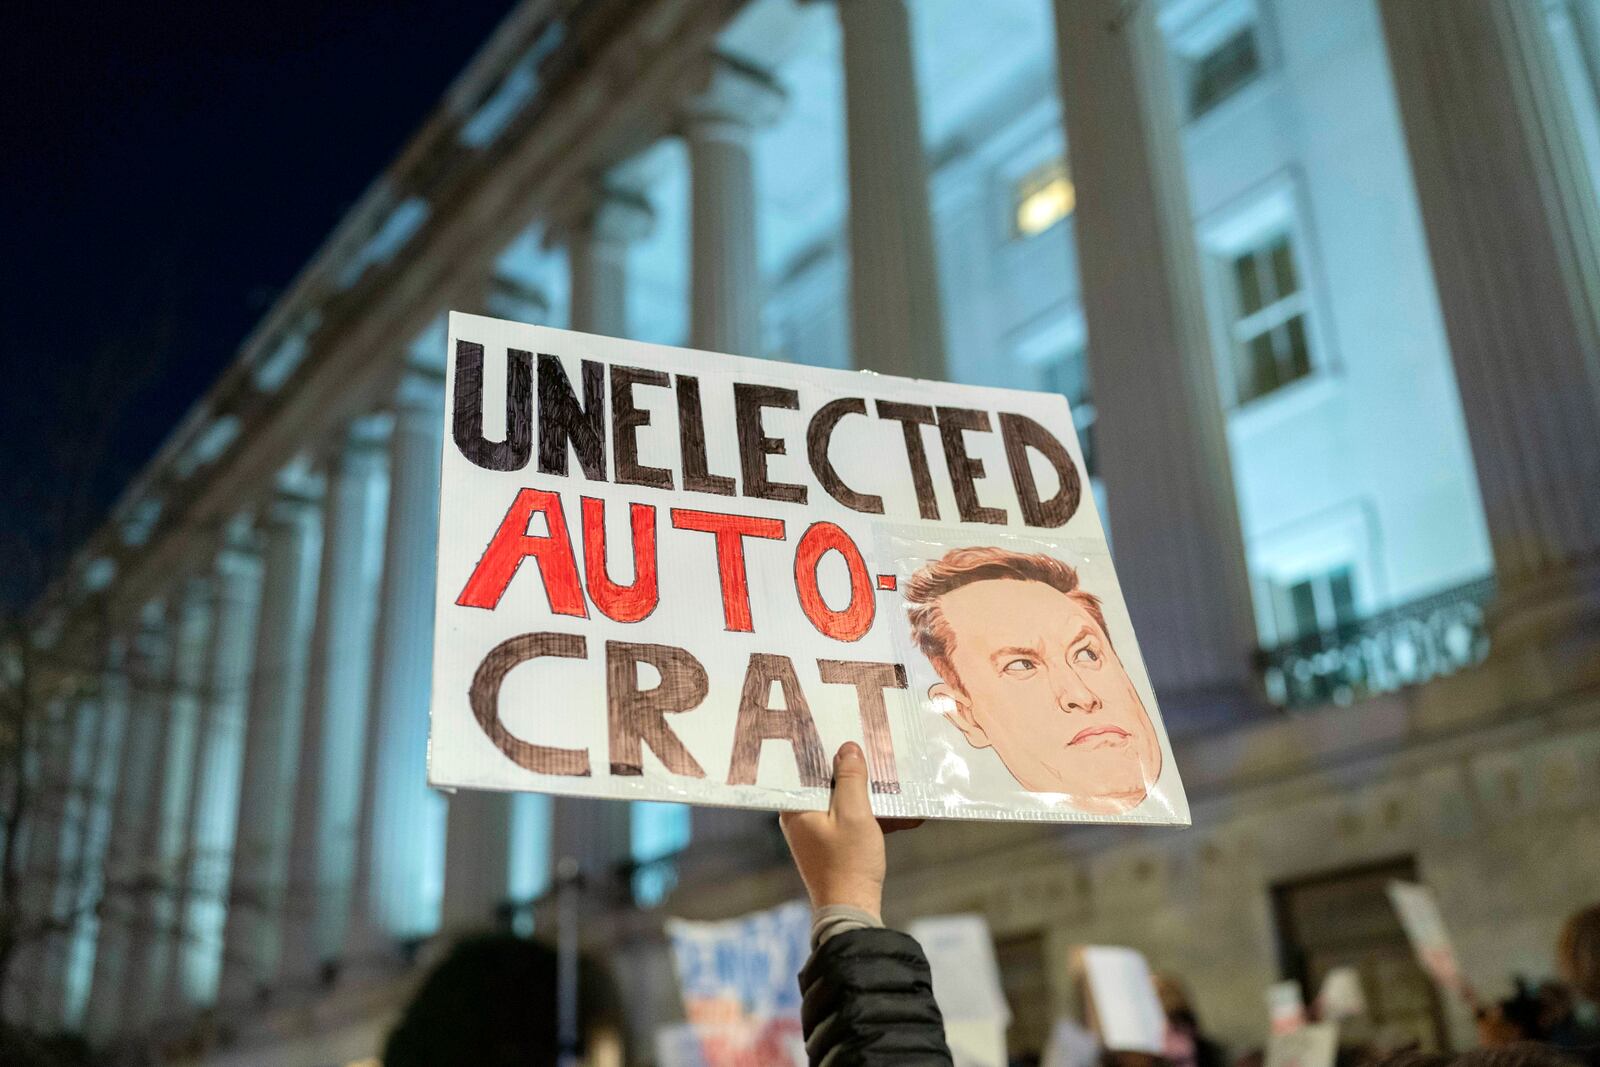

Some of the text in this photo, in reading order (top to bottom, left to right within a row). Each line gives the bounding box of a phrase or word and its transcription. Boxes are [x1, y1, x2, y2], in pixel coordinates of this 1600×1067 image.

[452, 339, 1082, 529] UNELECTED
[455, 487, 897, 643] AUTO-
[468, 631, 908, 793] CRAT
